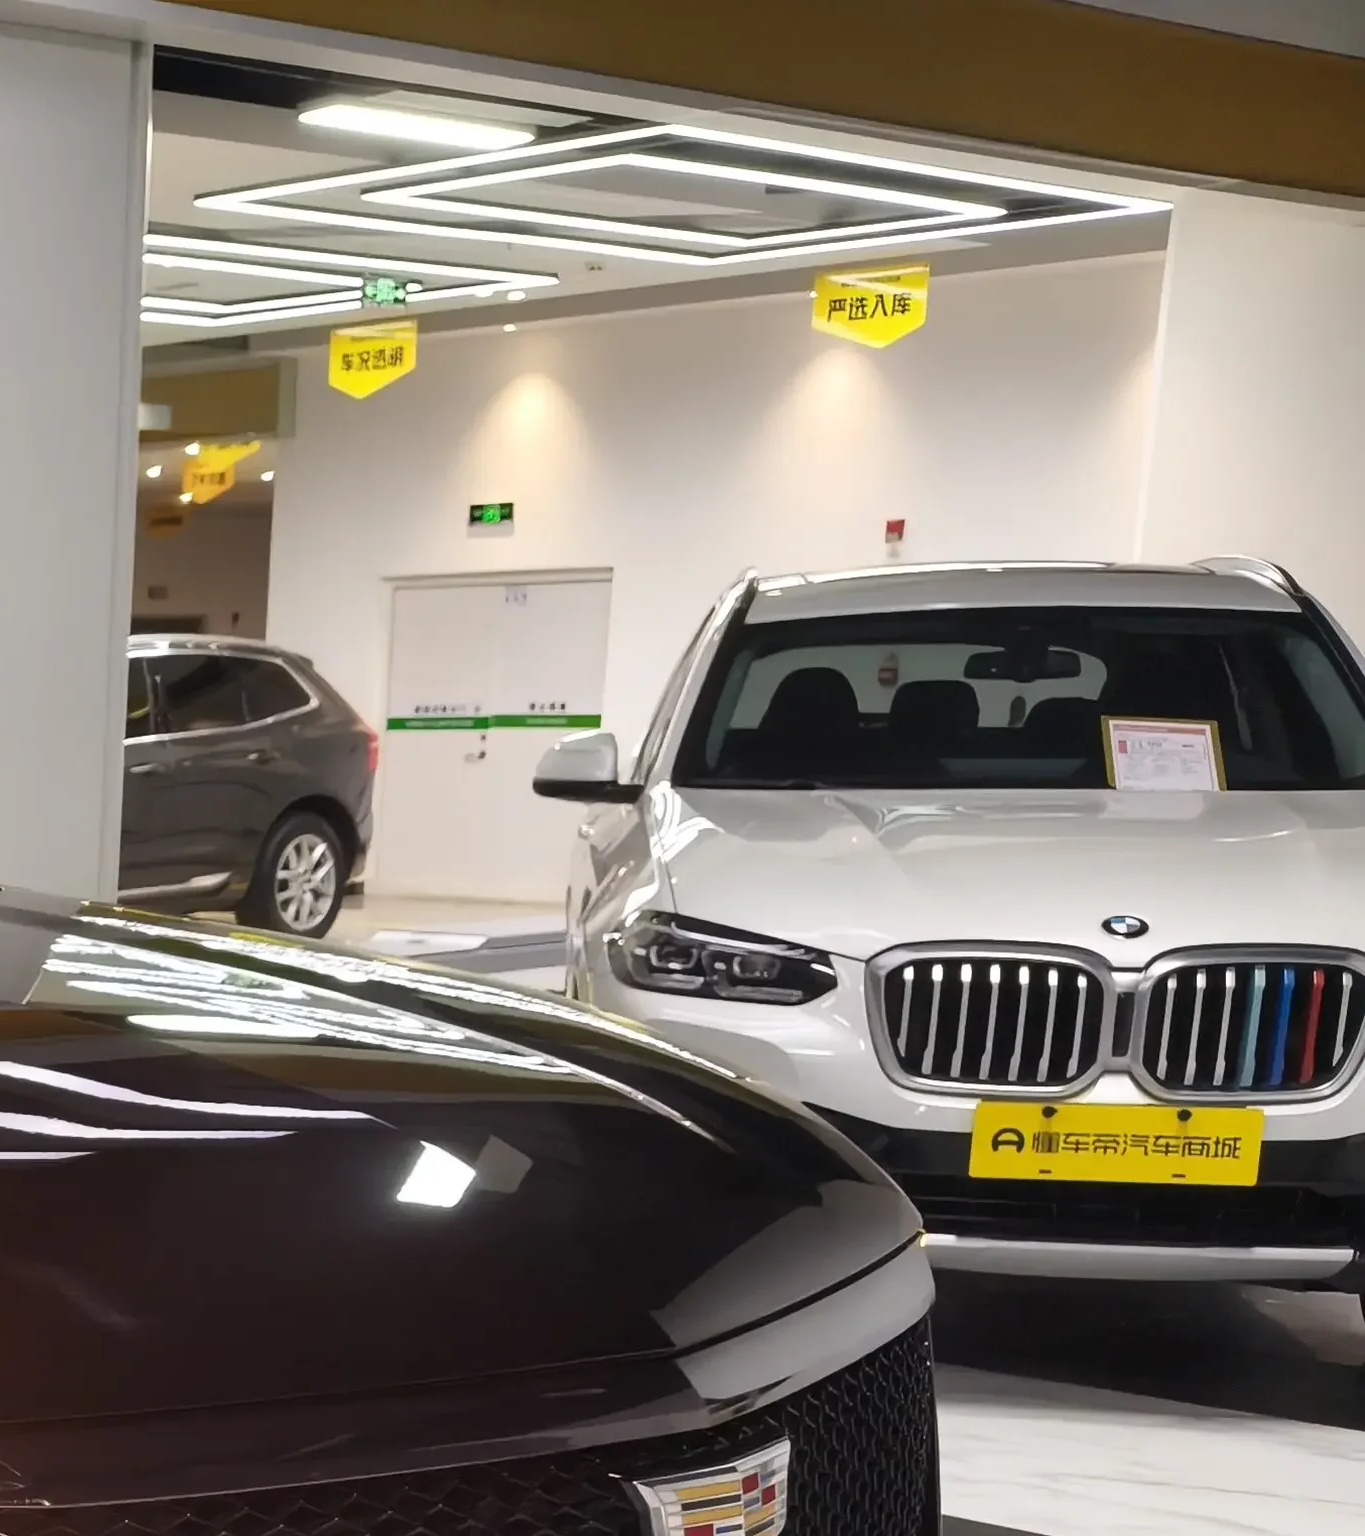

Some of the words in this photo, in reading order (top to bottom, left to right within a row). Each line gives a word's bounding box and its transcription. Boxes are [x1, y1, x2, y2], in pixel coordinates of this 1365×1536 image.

[827, 292, 912, 322] 严选入库
[341, 345, 404, 371] 车况透明
